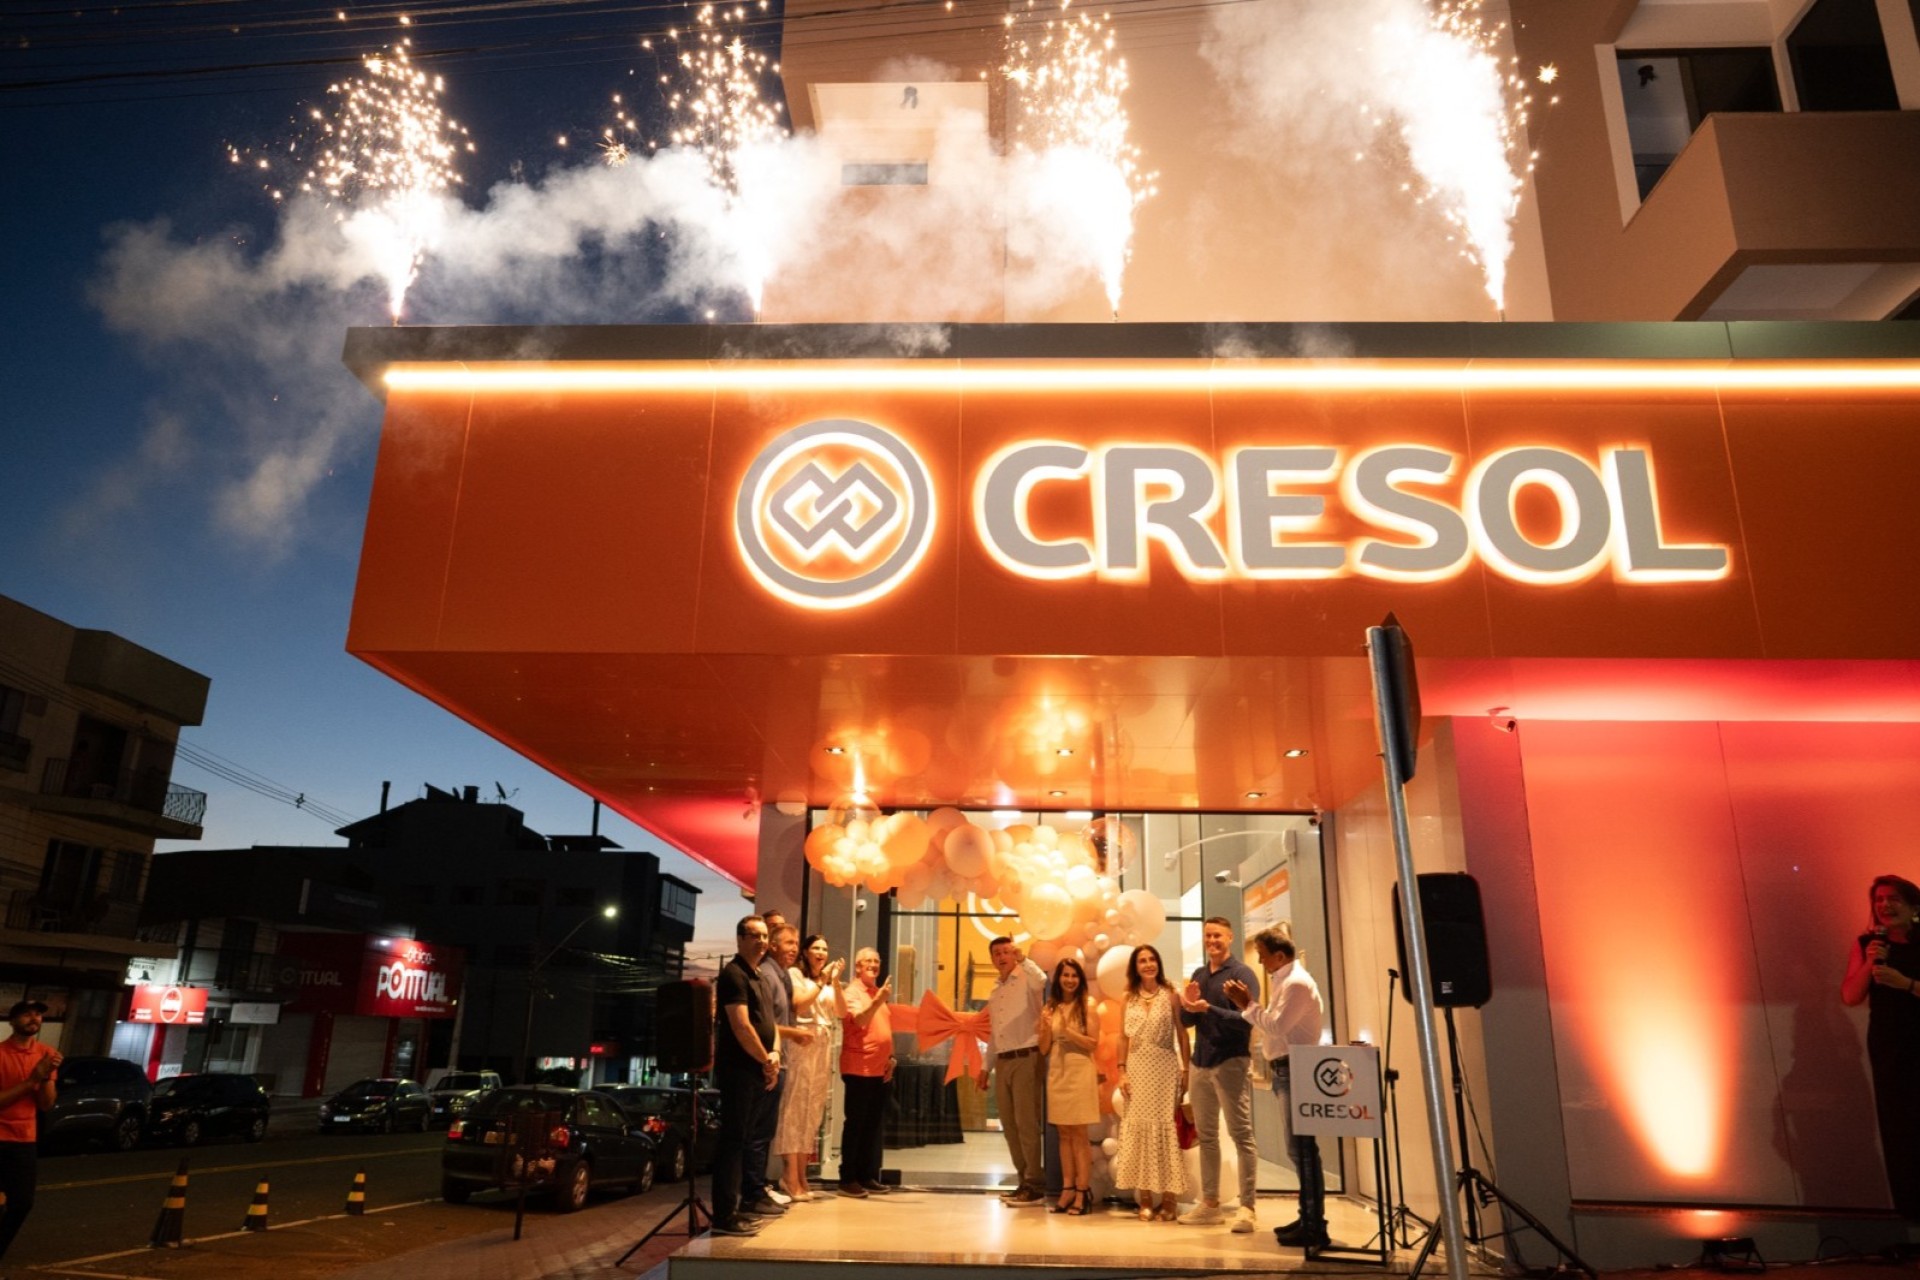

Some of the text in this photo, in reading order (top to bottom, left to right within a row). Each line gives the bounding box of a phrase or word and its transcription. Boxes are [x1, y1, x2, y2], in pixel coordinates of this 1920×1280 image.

[981, 442, 1729, 578] CRESOL
[376, 961, 448, 1003] PONTUAL
[1299, 1102, 1375, 1120] CRESOL
